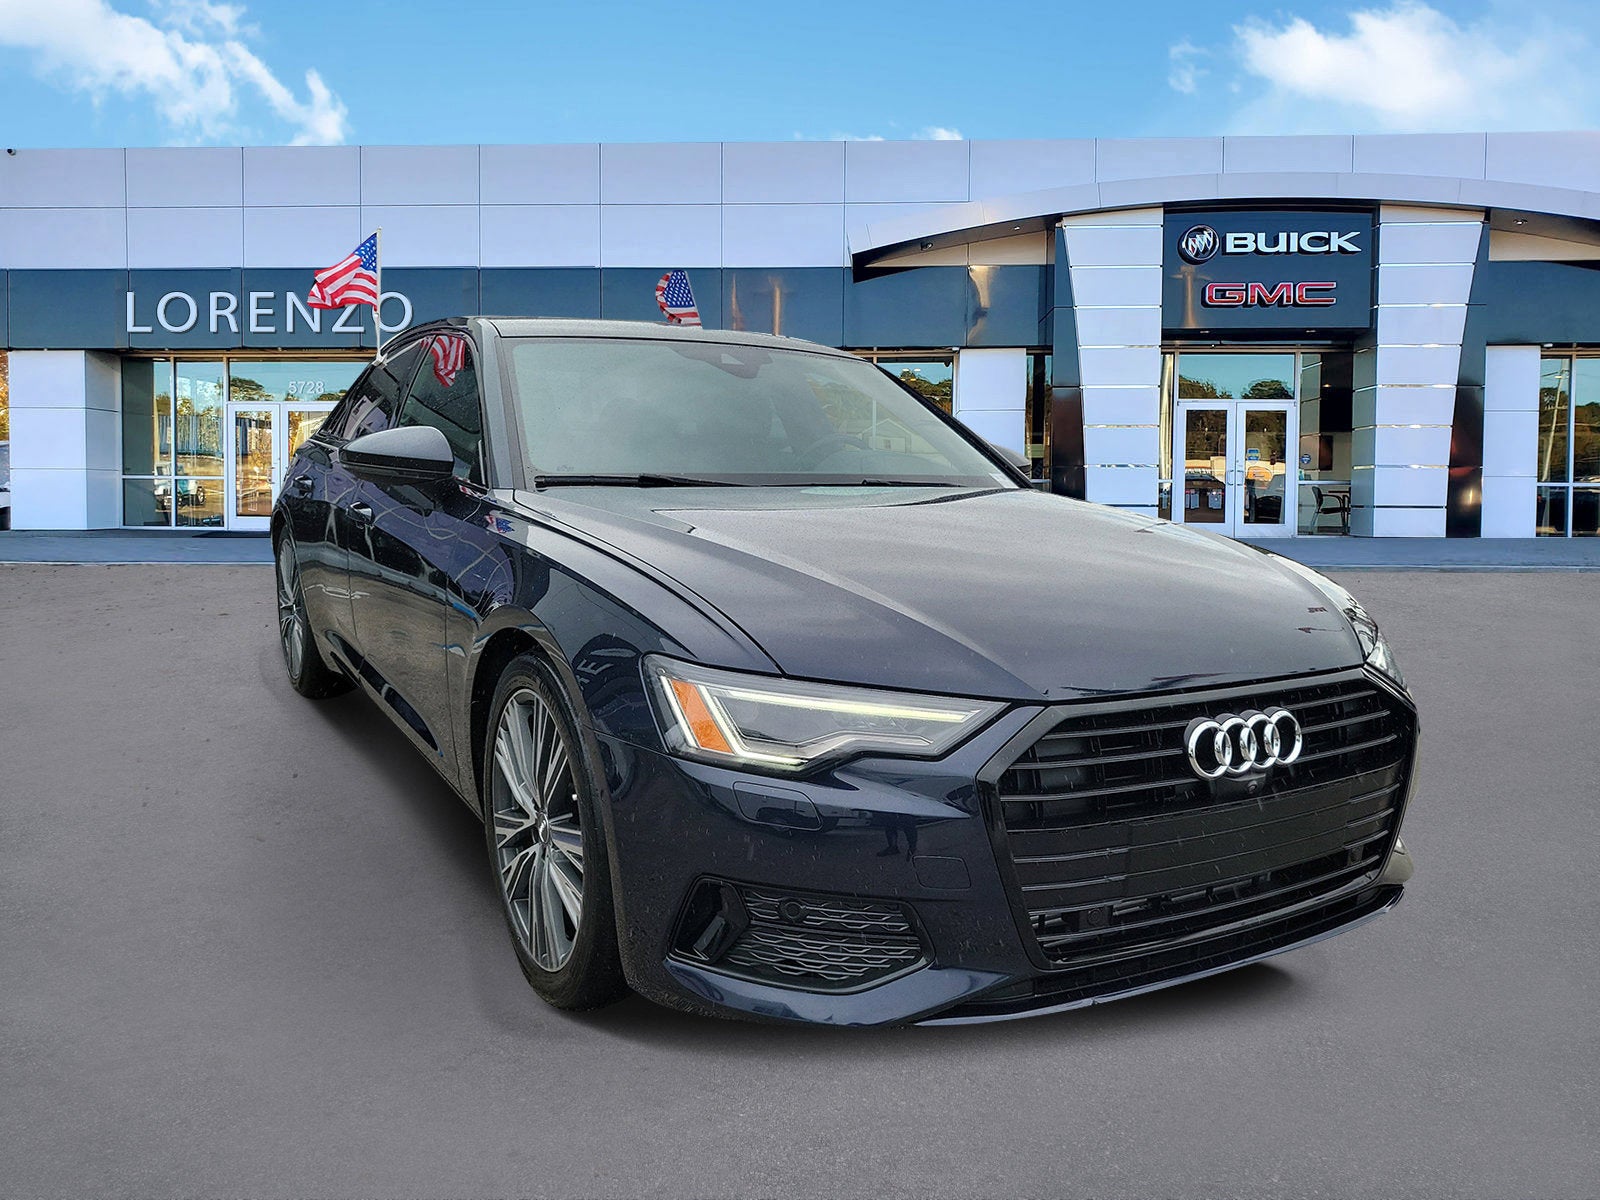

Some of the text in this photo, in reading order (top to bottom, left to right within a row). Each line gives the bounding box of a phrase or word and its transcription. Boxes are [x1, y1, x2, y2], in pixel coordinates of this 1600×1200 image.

[1225, 231, 1362, 253] BUICK
[1205, 281, 1337, 306] GMC
[125, 290, 413, 334] LORENZO
[288, 380, 326, 395] 5728
